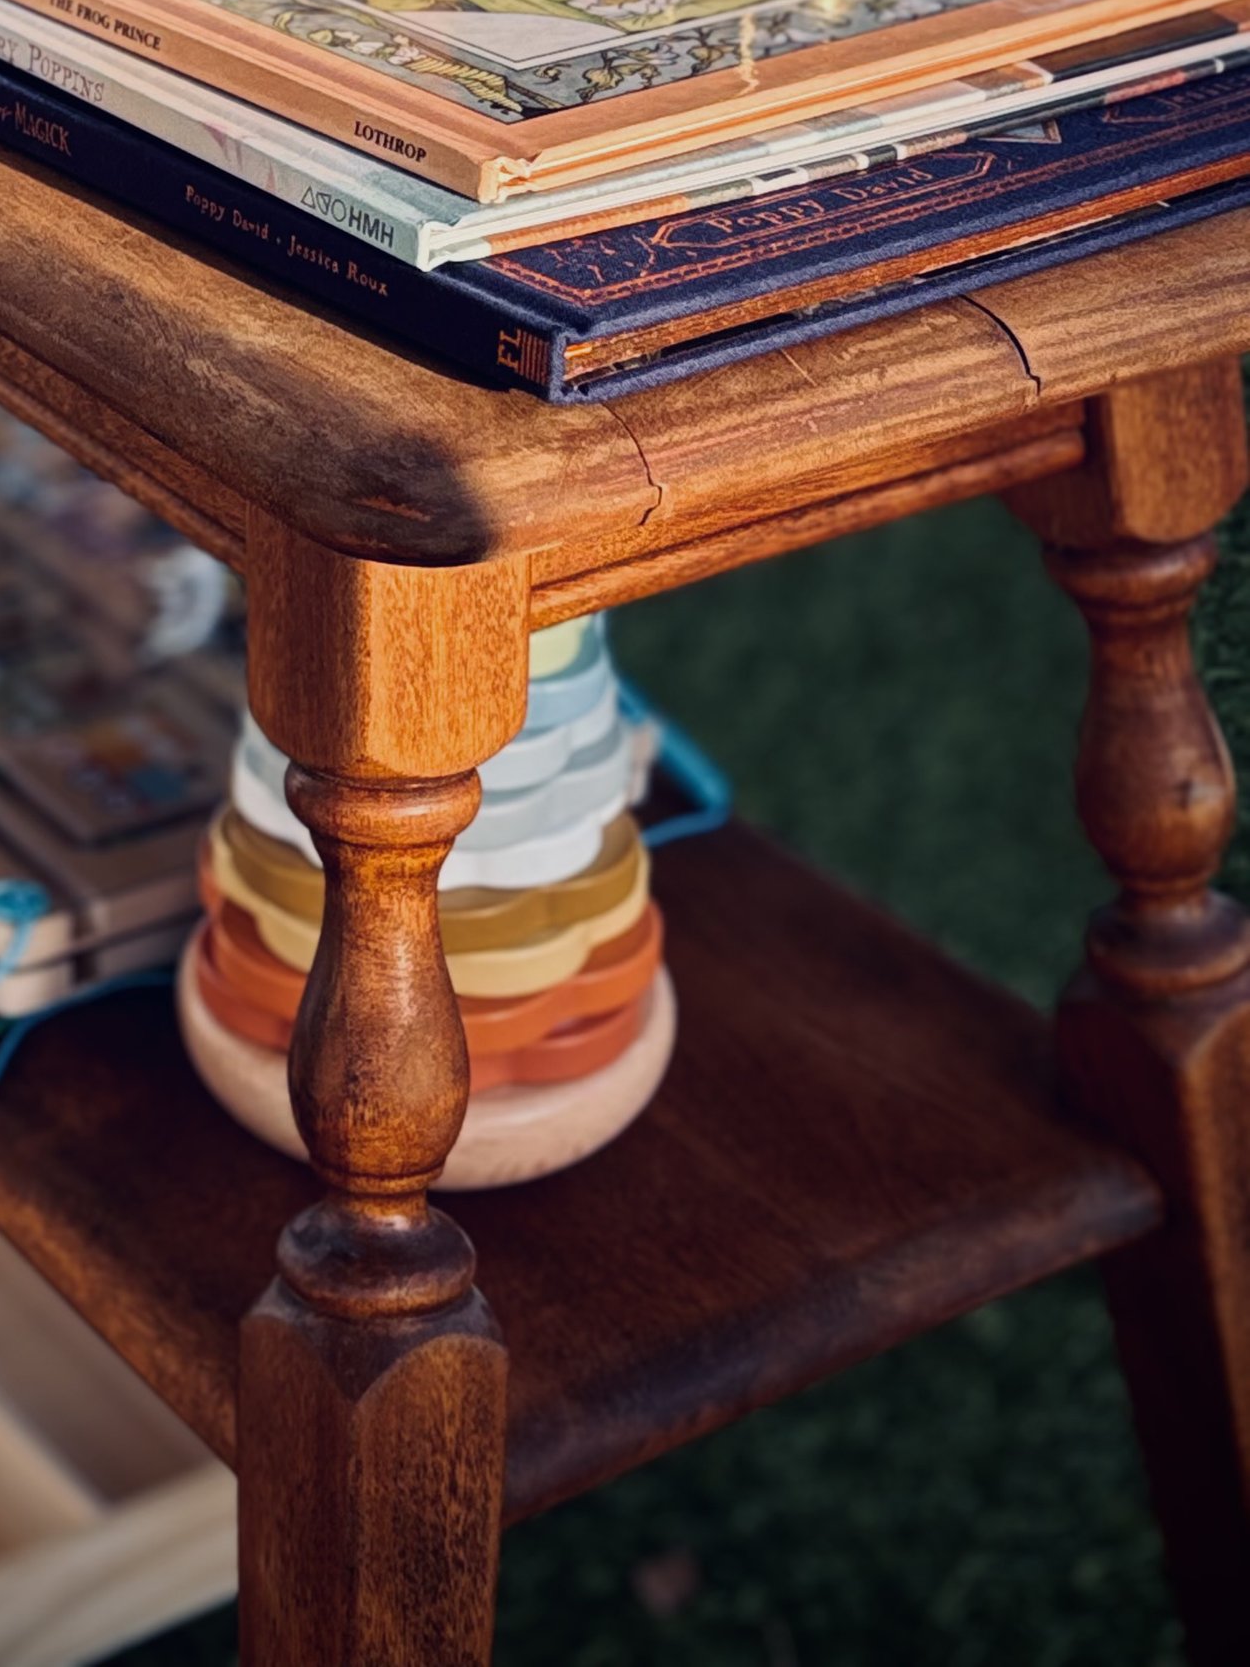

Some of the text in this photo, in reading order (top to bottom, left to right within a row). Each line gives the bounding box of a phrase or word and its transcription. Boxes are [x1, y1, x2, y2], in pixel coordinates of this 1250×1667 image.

[76, 3, 111, 29] FROG
[113, 19, 162, 51] PRINCE
[28, 44, 105, 102] POPPINS
[14, 101, 72, 156] MAGICK
[354, 121, 427, 163] LOTHROP
[348, 205, 395, 248] HMH
[706, 168, 933, 233] Poppy David
[184, 184, 389, 298] Poppy David Jessica Roux
